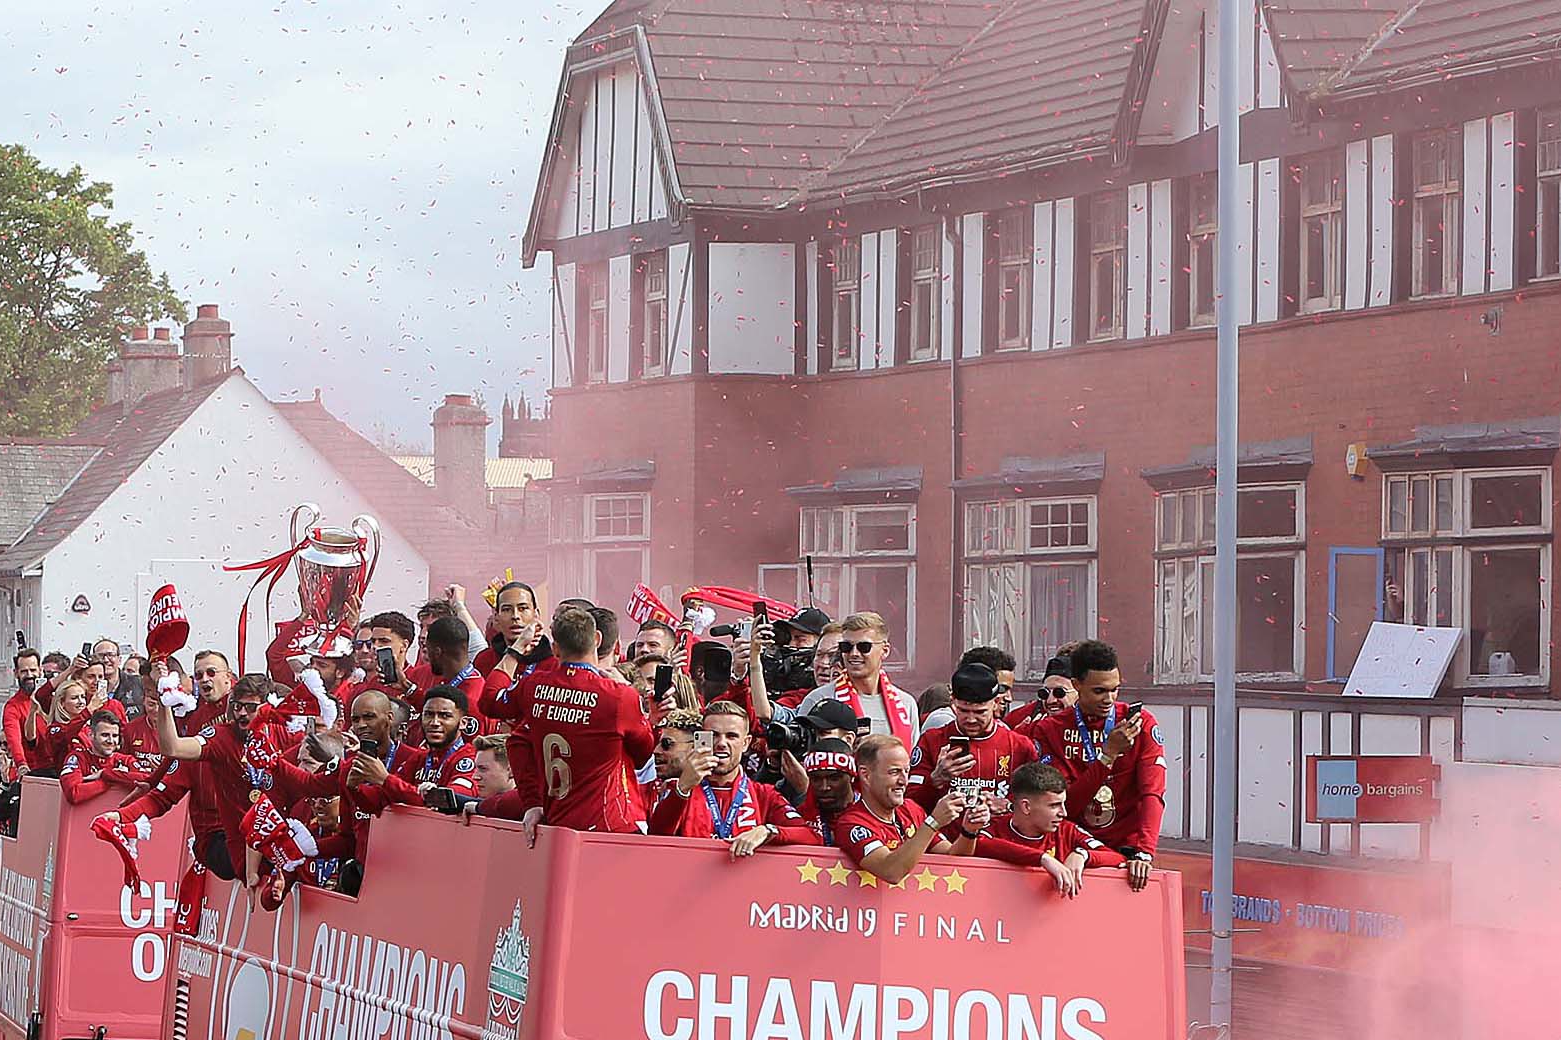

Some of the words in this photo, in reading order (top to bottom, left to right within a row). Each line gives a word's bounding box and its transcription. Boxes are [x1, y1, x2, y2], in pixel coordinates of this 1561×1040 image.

[535, 685, 598, 708] CHAMPIONS
[532, 703, 544, 718] OF
[546, 707, 591, 725] EUROPE
[542, 733, 572, 800] 6
[950, 777, 996, 789] Standard
[1322, 782, 1361, 796] home
[1367, 782, 1423, 798] bargains
[1232, 895, 1282, 925] BRANDS
[1296, 903, 1351, 931] BOTTOM
[858, 906, 878, 937] 19
[893, 912, 1011, 944] FINAL
